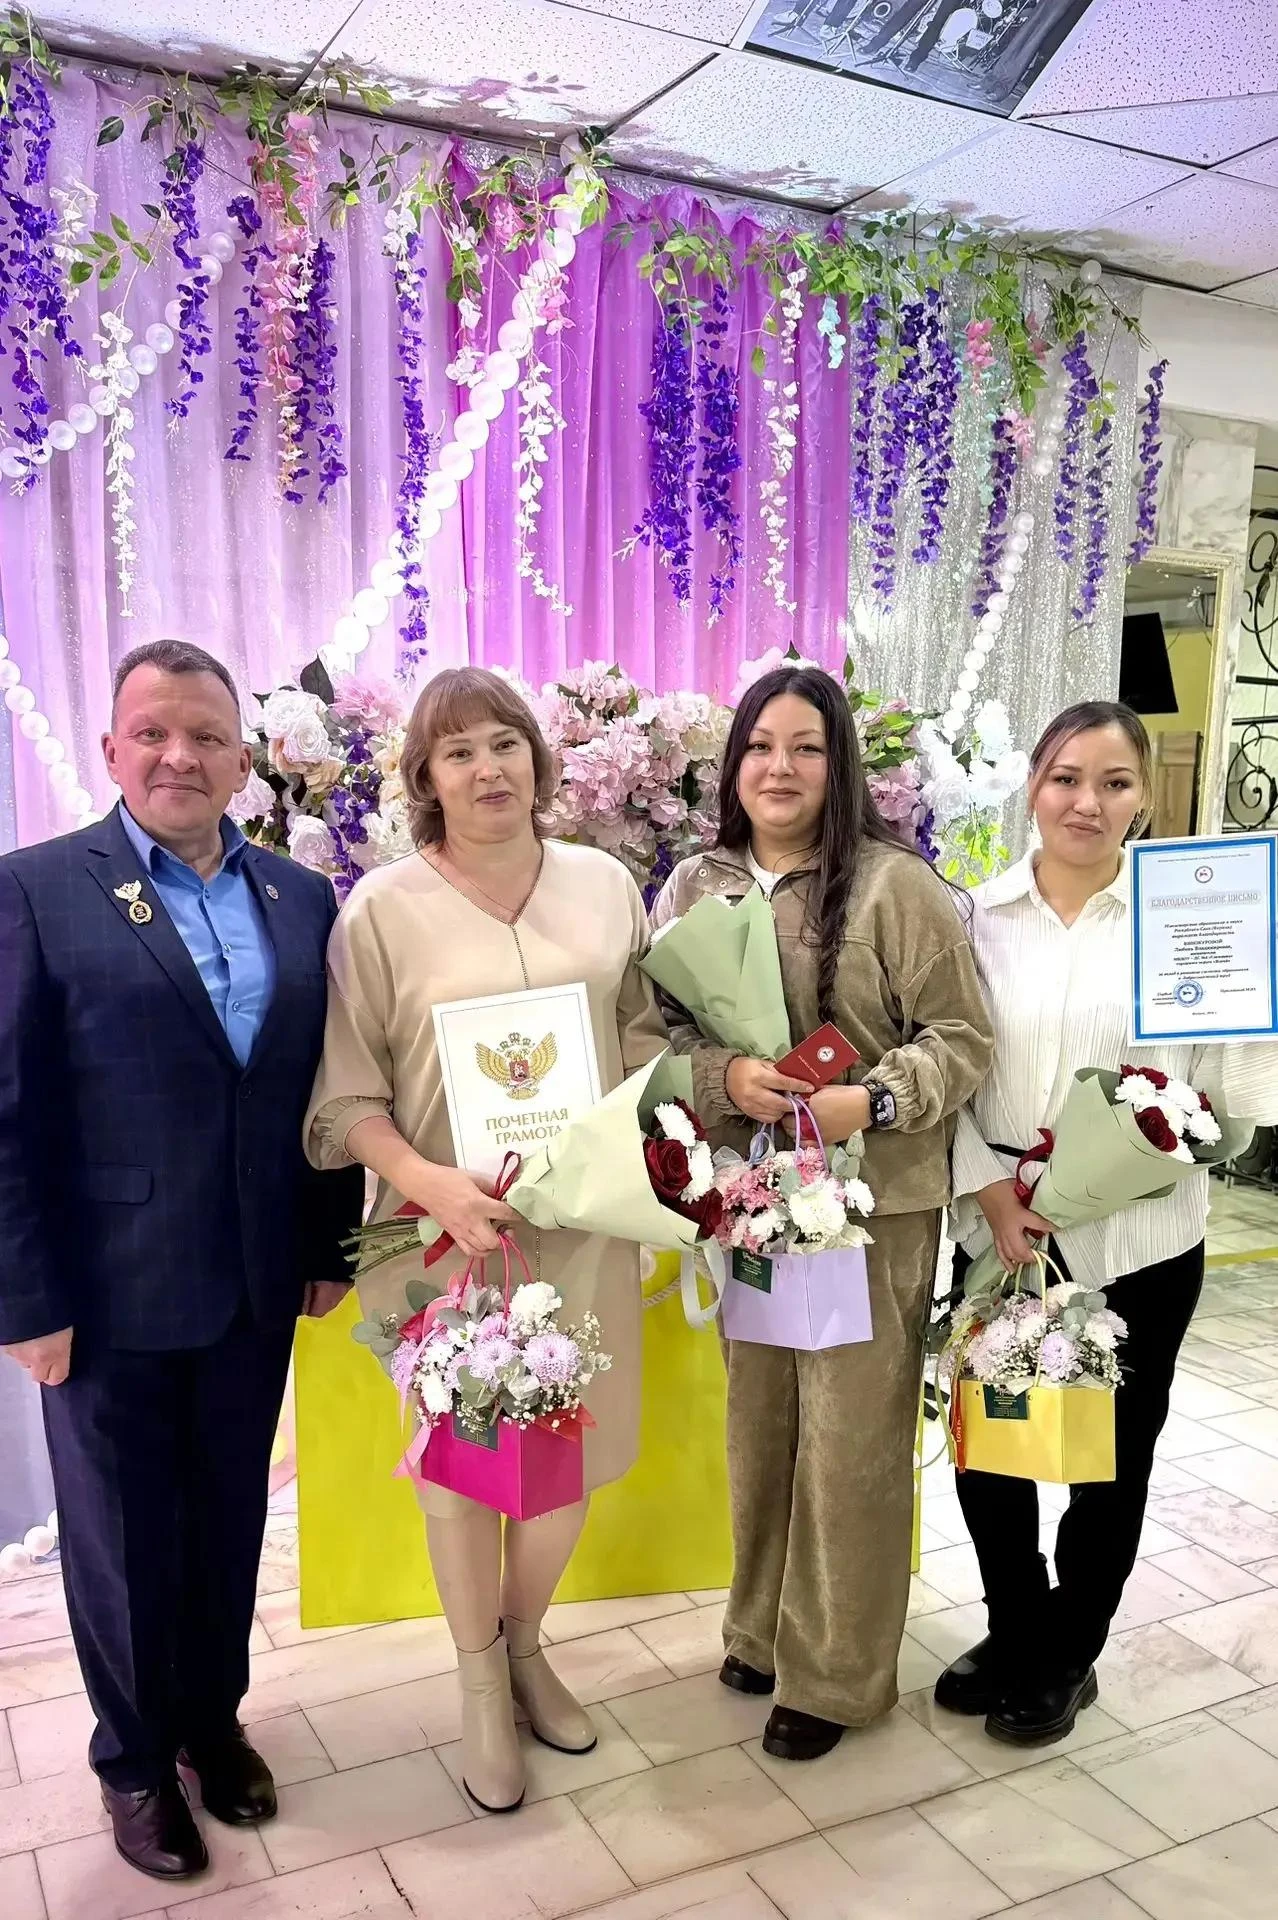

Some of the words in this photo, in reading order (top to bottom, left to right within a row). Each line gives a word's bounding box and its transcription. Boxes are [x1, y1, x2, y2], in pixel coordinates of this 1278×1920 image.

[1151, 894, 1226, 908] БЛАГОДАРСТВЕННОЕ
[1227, 893, 1258, 904] ПИСЬМО
[486, 1107, 569, 1131] ПОЧЕТНАЯ
